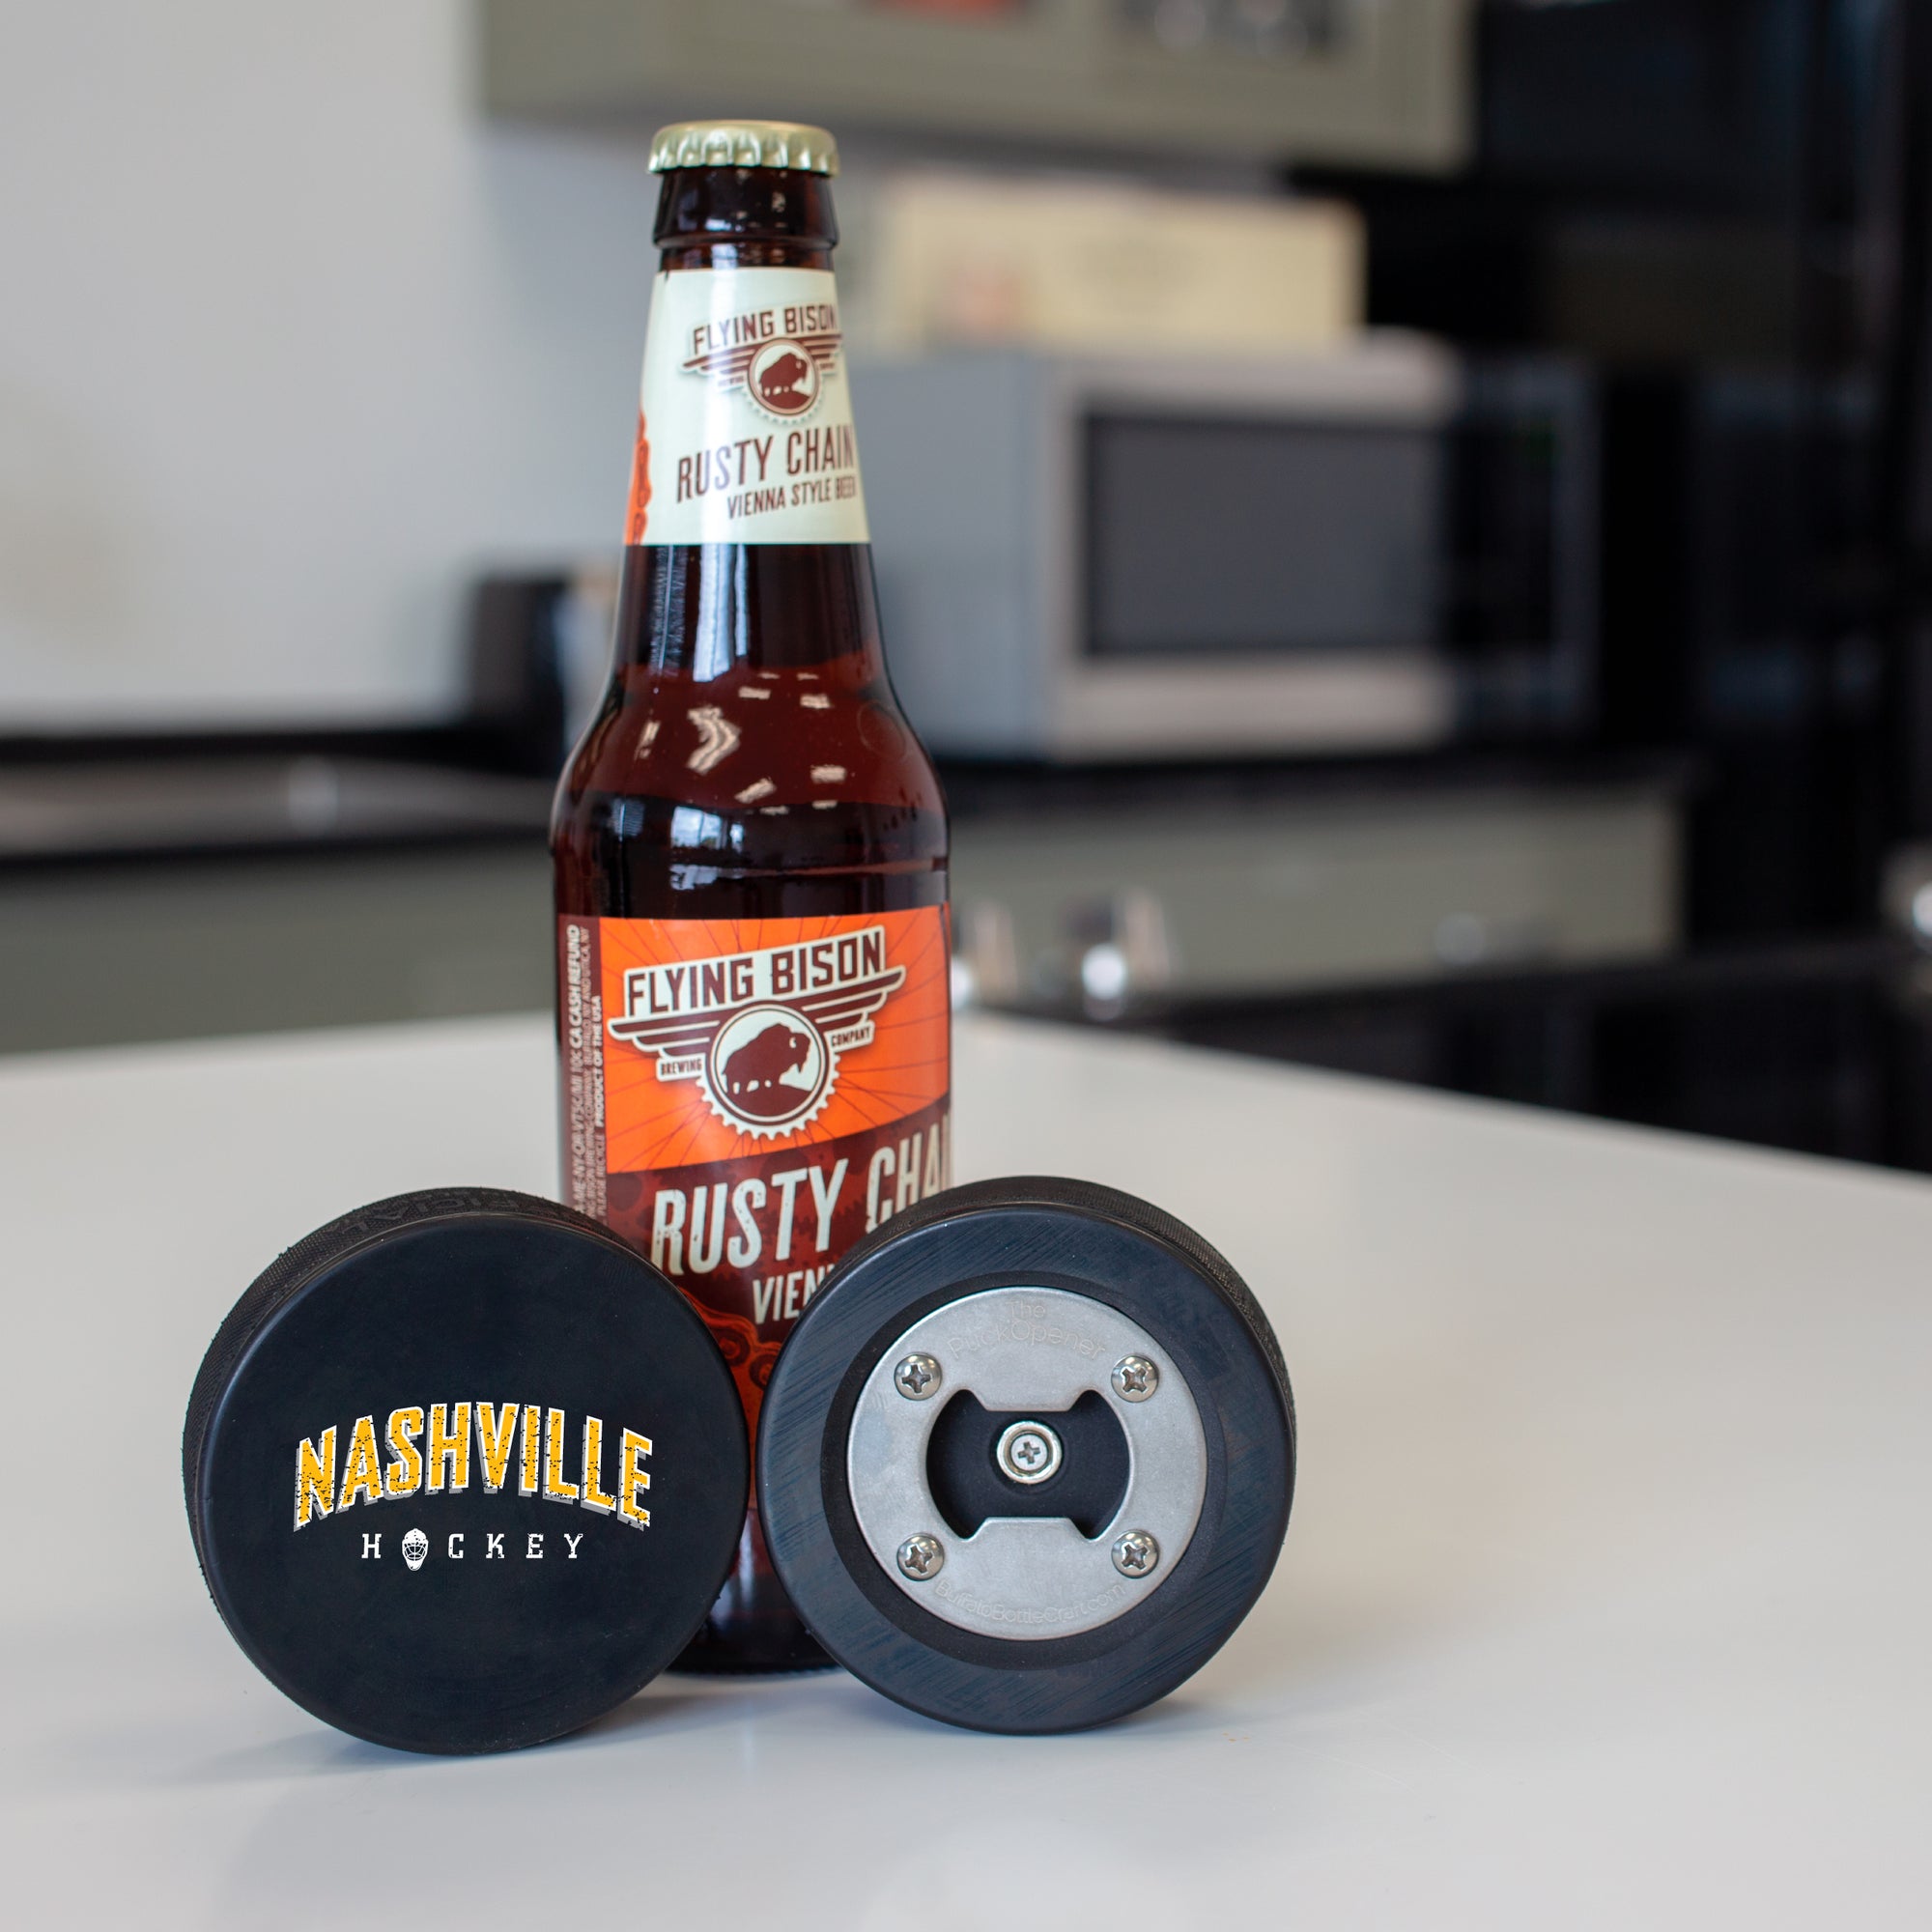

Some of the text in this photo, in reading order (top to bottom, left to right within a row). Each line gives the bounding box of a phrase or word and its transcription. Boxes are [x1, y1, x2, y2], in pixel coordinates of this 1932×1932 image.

[693, 310, 775, 355] FLYING
[676, 423, 855, 503] RUSTY CHAIN
[726, 486, 786, 520] VIENNA
[791, 481, 831, 507] STYLE
[566, 924, 582, 984] REFUND
[627, 930, 885, 1017] FLYING BISON
[568, 984, 582, 1026] CASH
[590, 995, 602, 1022] USA
[591, 1023, 603, 1046] THE
[592, 1046, 604, 1066] OF
[660, 1025, 871, 1076] BREWING COMPANY
[593, 1067, 605, 1127] PRODUCT
[650, 1158, 849, 1276] RUSTY
[753, 1264, 836, 1324] VIEN
[1006, 1298, 1046, 1319] The
[293, 1401, 653, 1531] NASHVILLE
